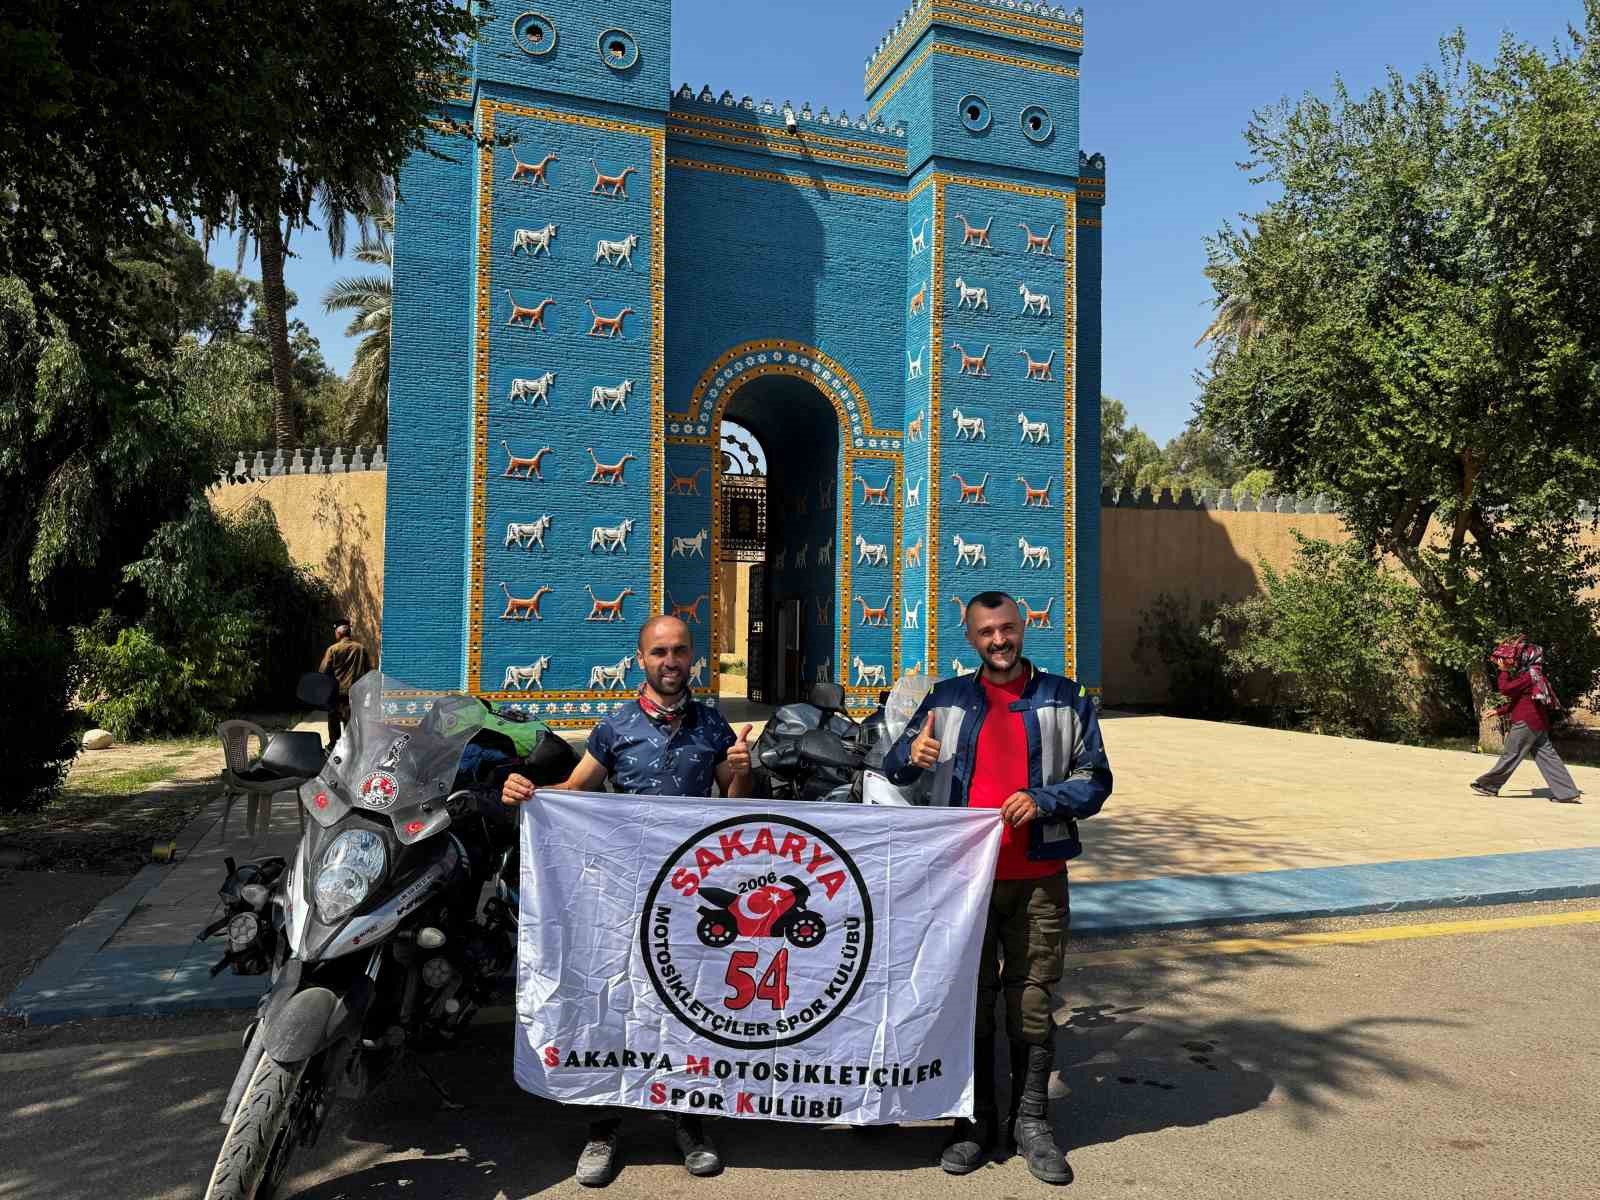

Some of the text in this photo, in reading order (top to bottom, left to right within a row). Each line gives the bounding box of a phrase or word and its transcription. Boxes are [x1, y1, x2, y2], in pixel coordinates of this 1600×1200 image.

[671, 826, 848, 900] SAKARYA
[737, 871, 777, 894] 2006
[653, 905, 862, 1036] MOTOSİKLETÇİLER SPOR KULÜBÜ
[723, 947, 789, 1010] 54
[544, 1046, 943, 1093] SAKARYA MOTOSİKLETÇİLER
[650, 1082, 843, 1118] SPOR KULÜBÜ
